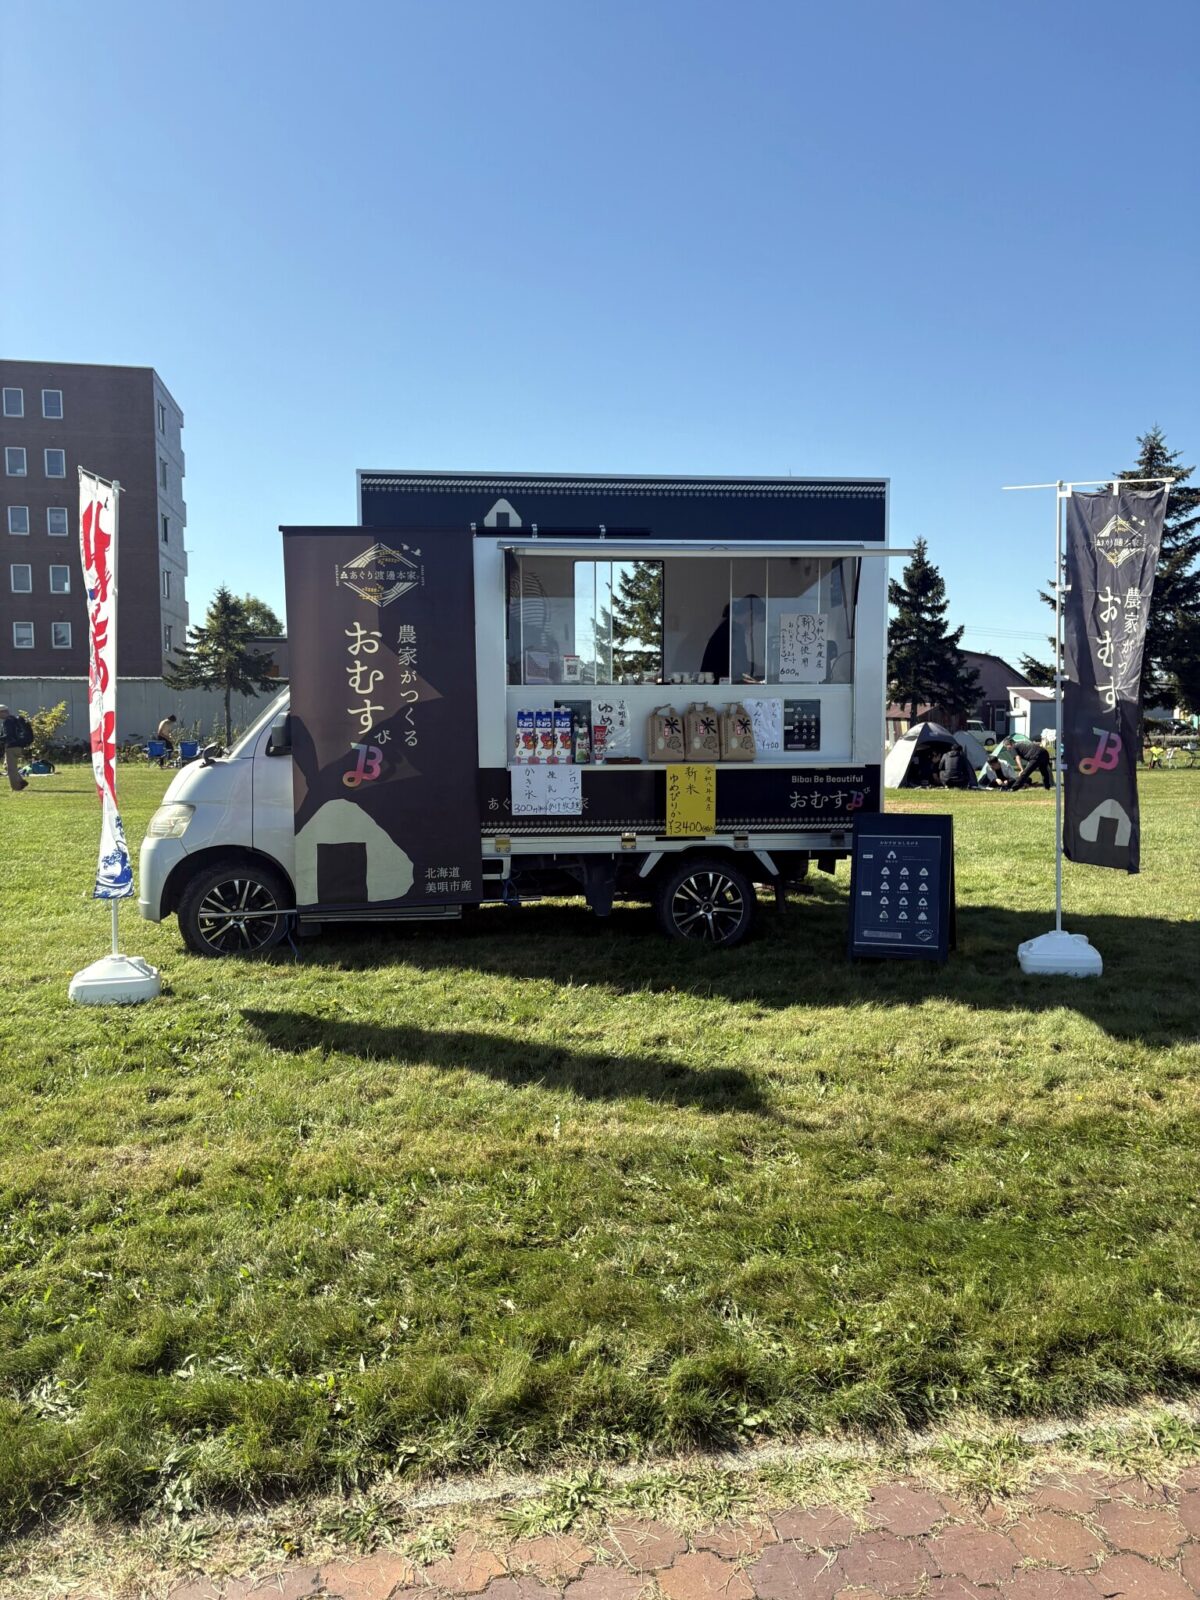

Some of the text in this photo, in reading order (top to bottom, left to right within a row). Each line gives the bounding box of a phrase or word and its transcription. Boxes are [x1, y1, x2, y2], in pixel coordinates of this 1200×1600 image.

[397, 624, 419, 747] 農家がつくる
[664, 717, 682, 735] 米
[700, 717, 717, 735] 米
[738, 717, 751, 735] 米
[374, 729, 392, 745] び
[524, 767, 537, 800] かき氷
[684, 766, 701, 796] 新米
[791, 774, 864, 783] Bibai Be Beautiful
[424, 866, 461, 879] 北海道
[424, 879, 473, 894] 美唄市産
